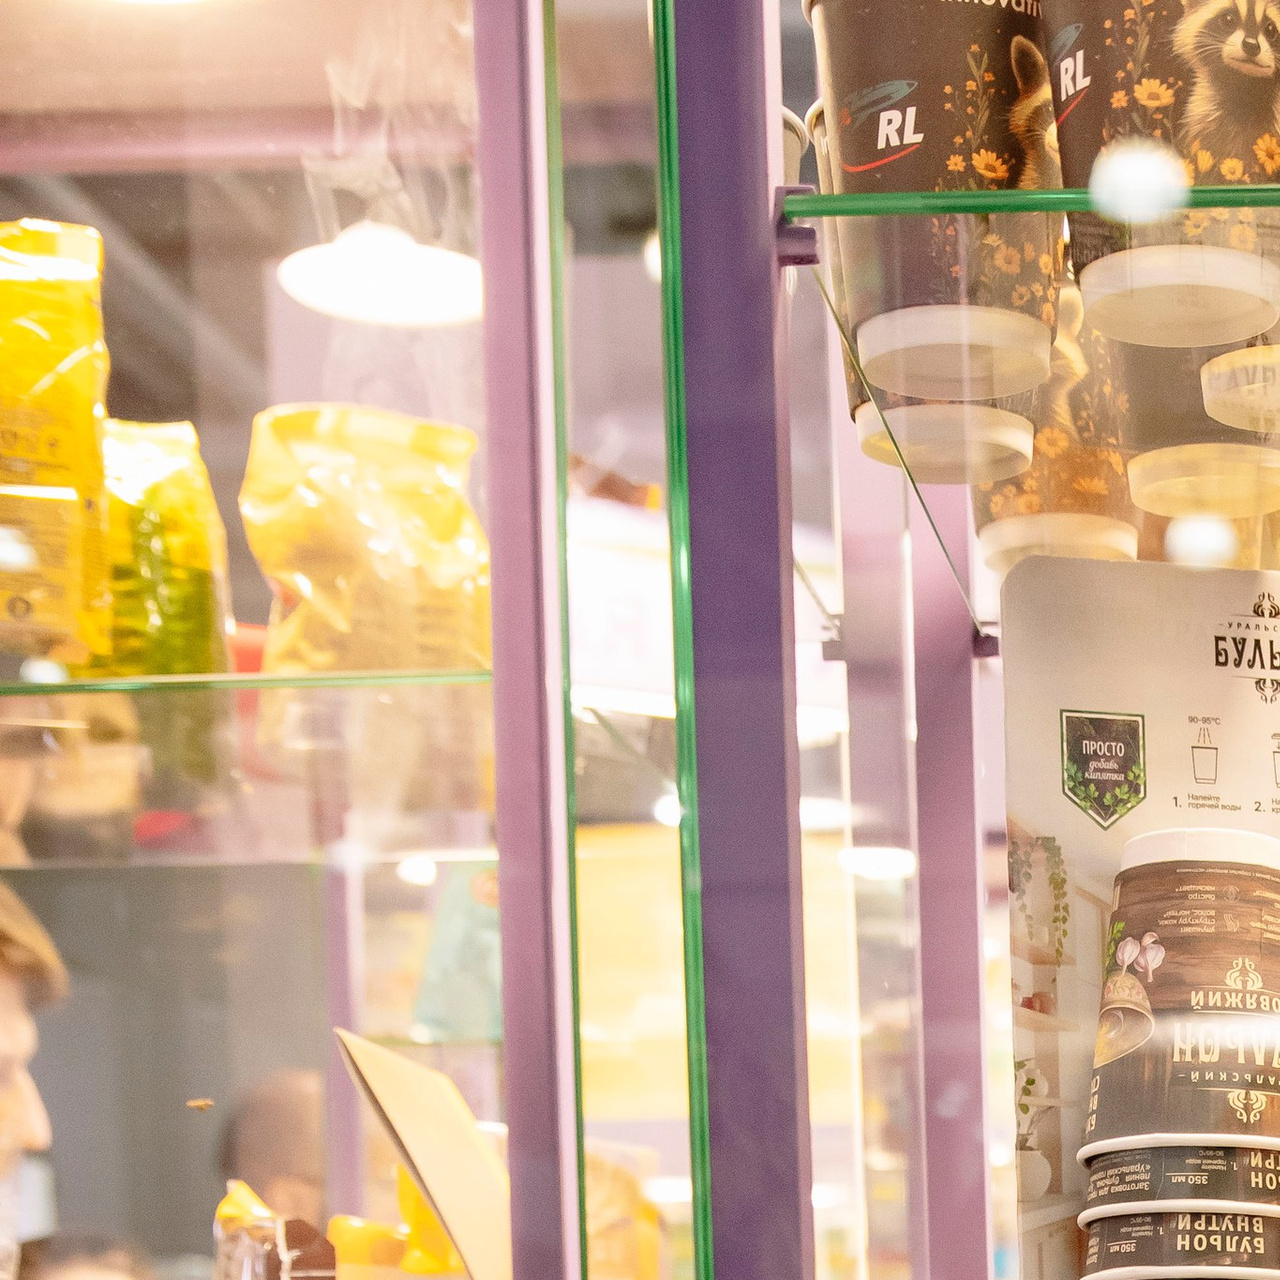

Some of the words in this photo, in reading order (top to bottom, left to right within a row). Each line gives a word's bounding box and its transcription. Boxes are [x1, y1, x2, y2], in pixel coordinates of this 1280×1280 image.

[1060, 50, 1092, 101] RL
[877, 106, 924, 150] RL
[1082, 741, 1125, 757] ПРОСТО
[1089, 759, 1119, 771] добавь
[1085, 770, 1125, 781] кипятка
[1254, 801, 1266, 813] 2.
[1188, 1175, 1208, 1184] 350
[1178, 1214, 1264, 1234] ВНУТРИ
[1120, 1244, 1136, 1252] 350
[1176, 1234, 1265, 1254] БУЛЬОН
